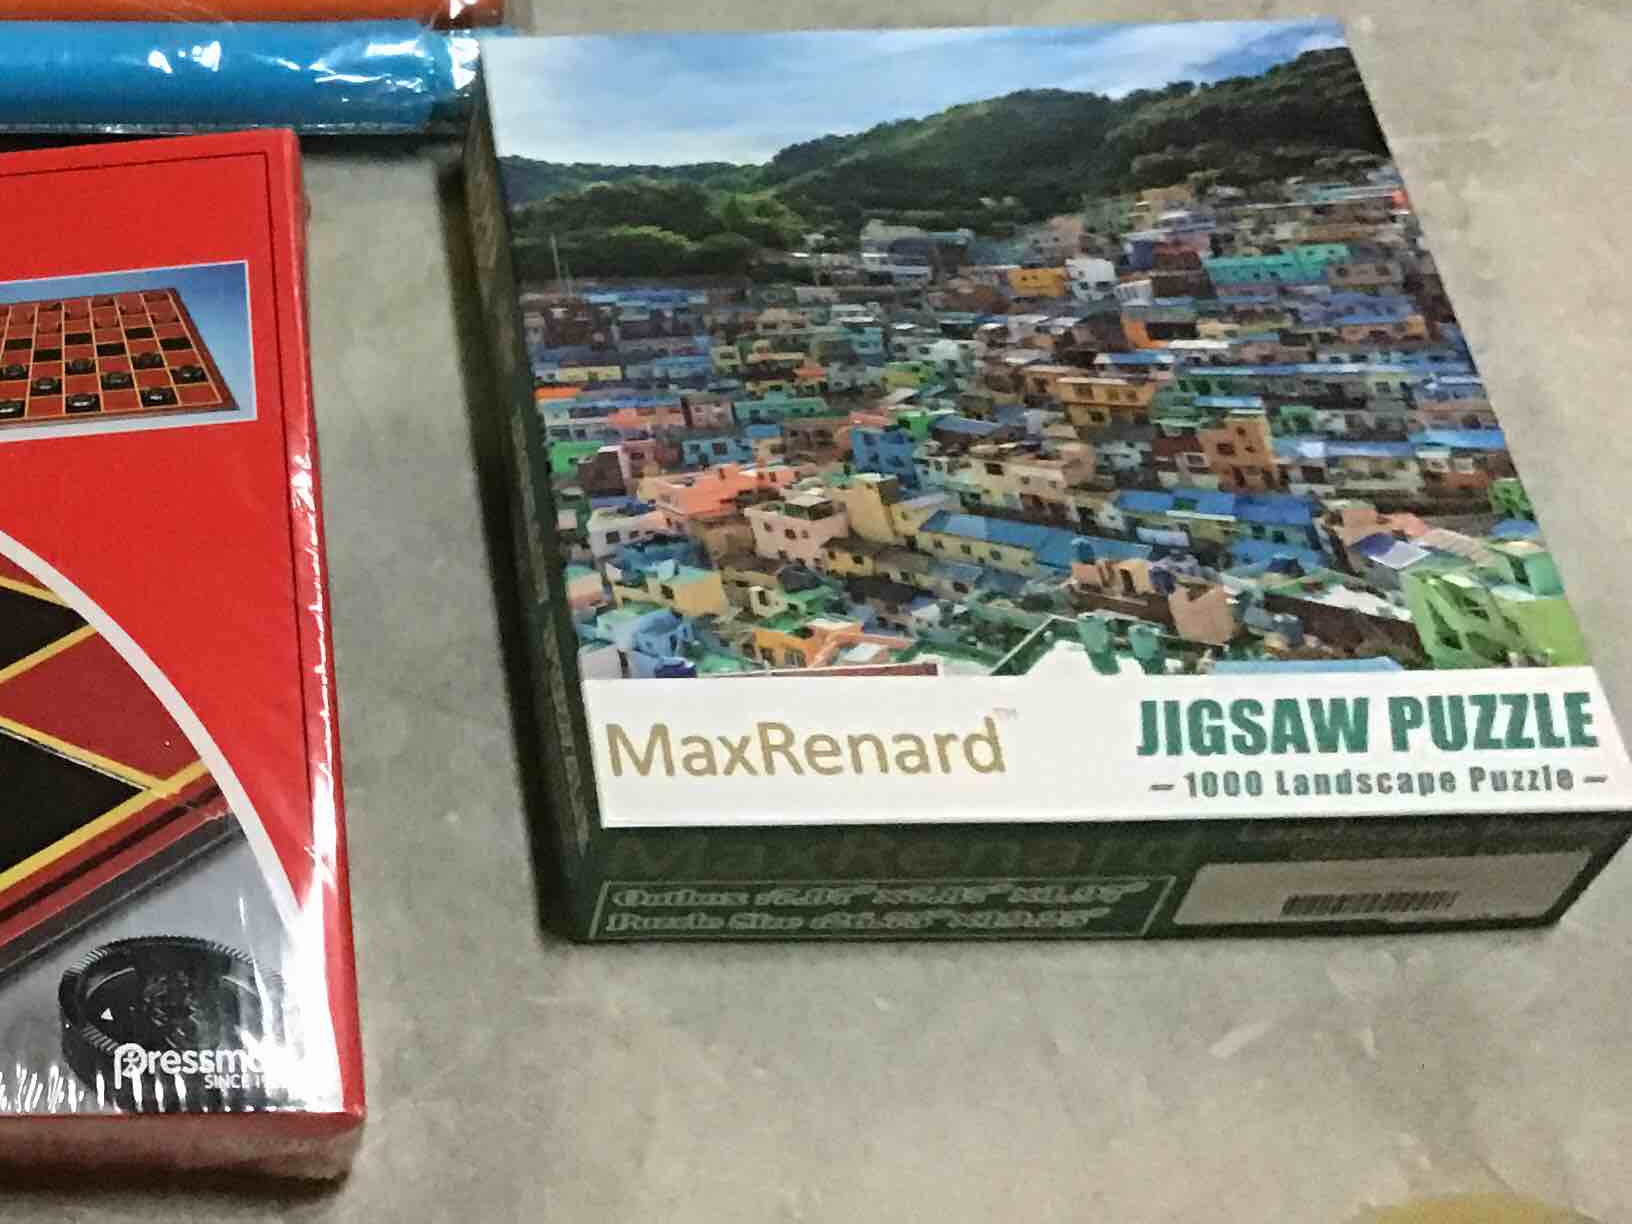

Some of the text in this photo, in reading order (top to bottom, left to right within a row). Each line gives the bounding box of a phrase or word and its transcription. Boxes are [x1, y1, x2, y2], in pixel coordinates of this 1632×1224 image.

[605, 716, 1007, 777] MaxRenard
[1136, 691, 1600, 757] JIGSAW PUZZLE
[1183, 765, 1575, 798] 1000 Landscape Puzzle
